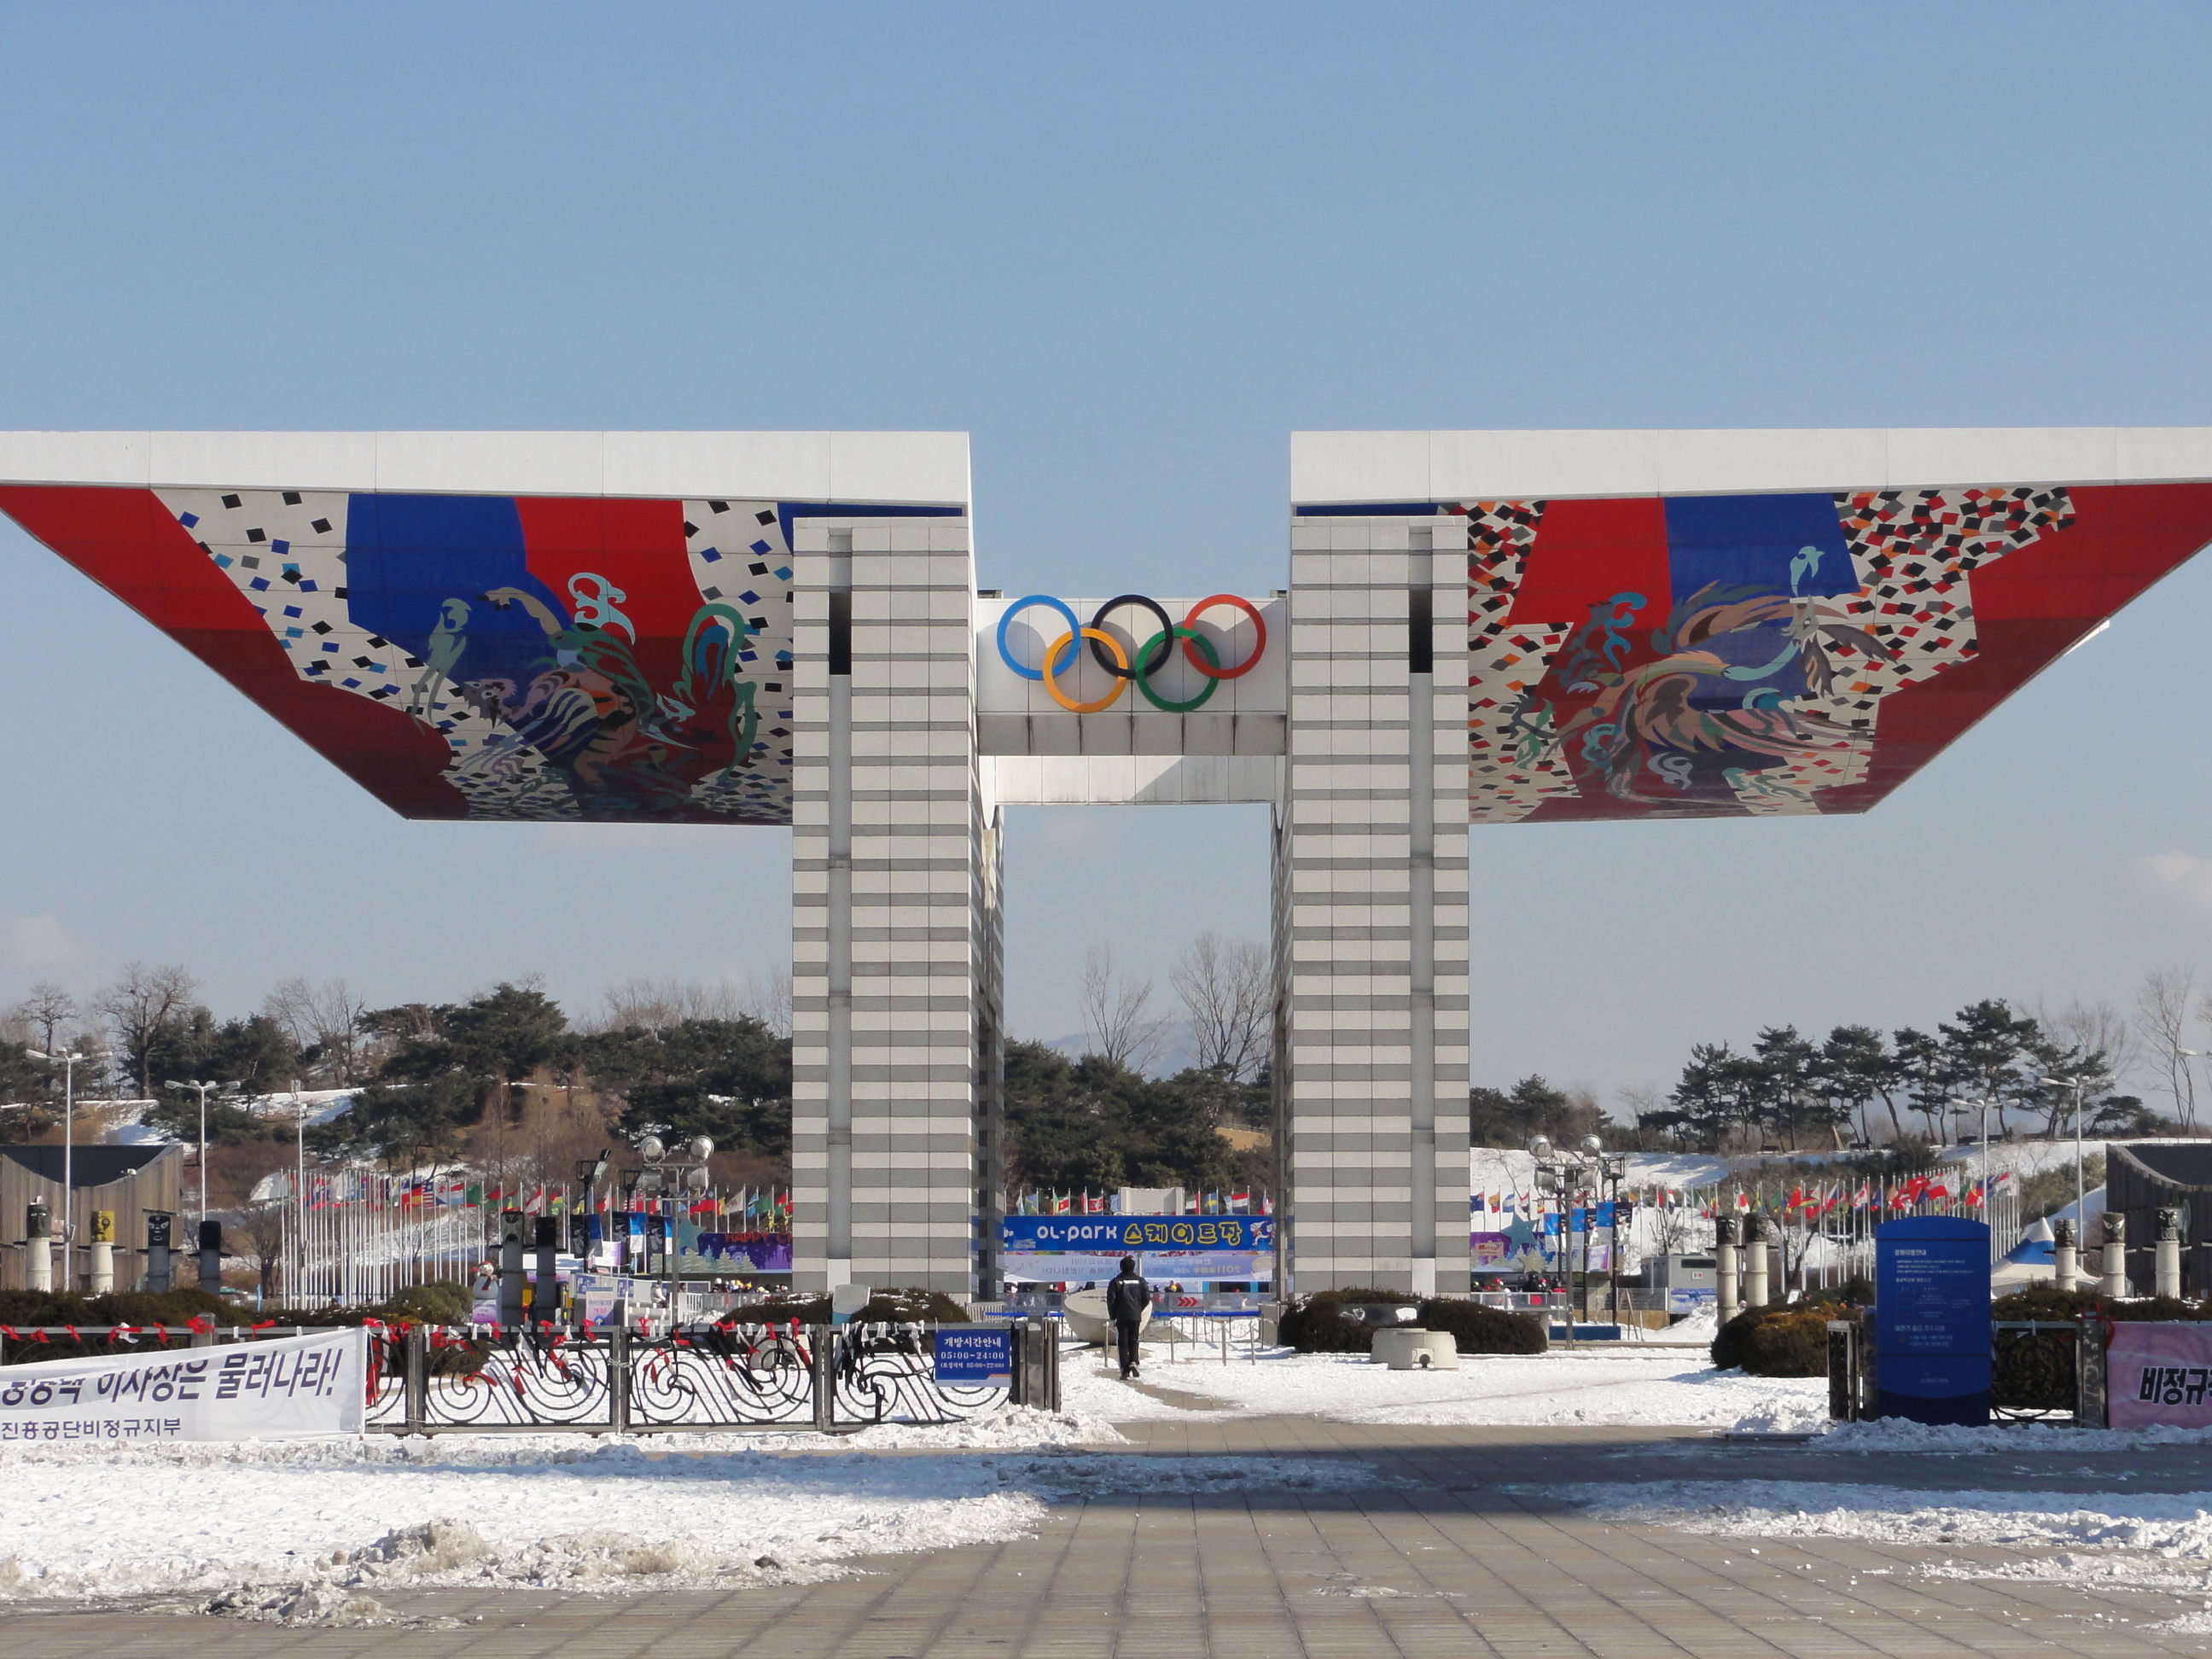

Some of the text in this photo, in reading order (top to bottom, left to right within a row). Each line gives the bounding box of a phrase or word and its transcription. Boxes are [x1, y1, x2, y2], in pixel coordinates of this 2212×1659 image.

[1123, 1220, 1243, 1246] 스케이트장
[944, 1336, 1002, 1348] 개방시간안내
[940, 1351, 1004, 1359] 05:00~24:00
[215, 1348, 344, 1400] 물러나라!
